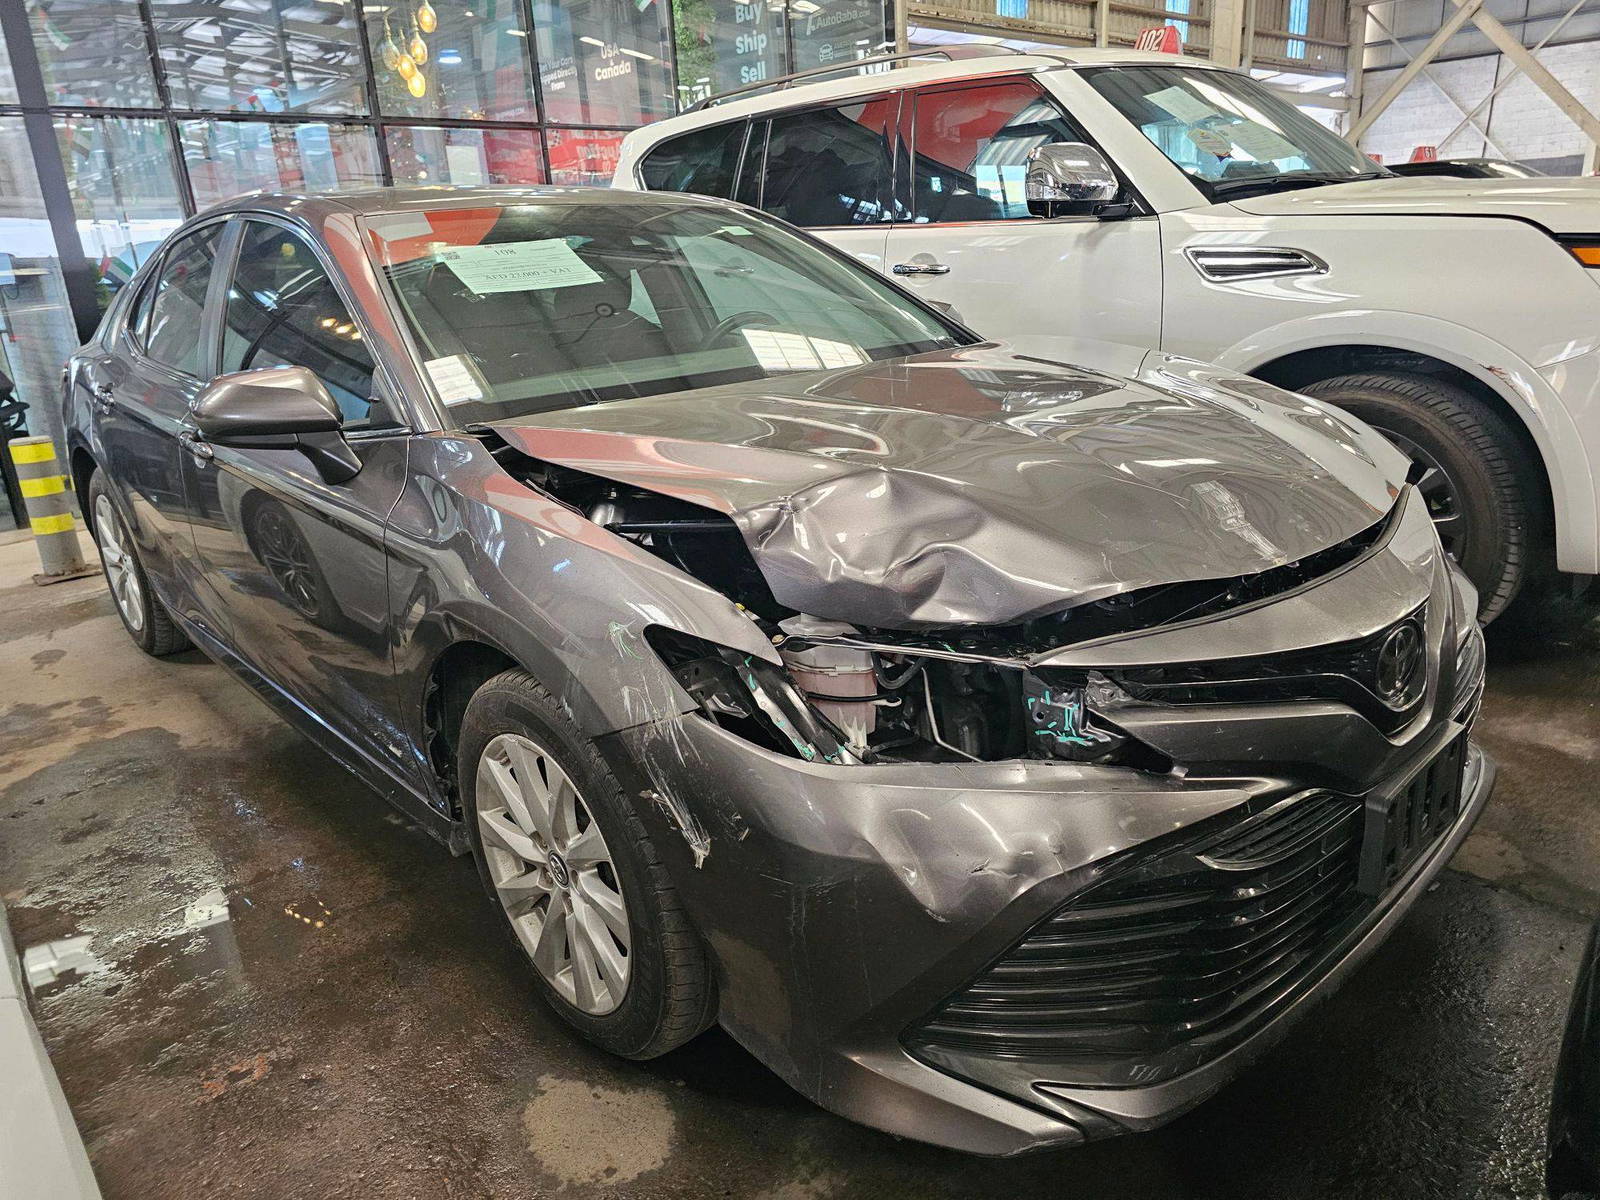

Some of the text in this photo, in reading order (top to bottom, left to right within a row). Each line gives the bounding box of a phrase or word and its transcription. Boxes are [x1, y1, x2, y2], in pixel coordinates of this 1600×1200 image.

[735, 2, 764, 25] Buy
[601, 42, 619, 59] USA
[735, 29, 767, 56] Ship
[1139, 29, 1165, 52] 102
[595, 61, 631, 80] Canada
[740, 60, 767, 84] Sell
